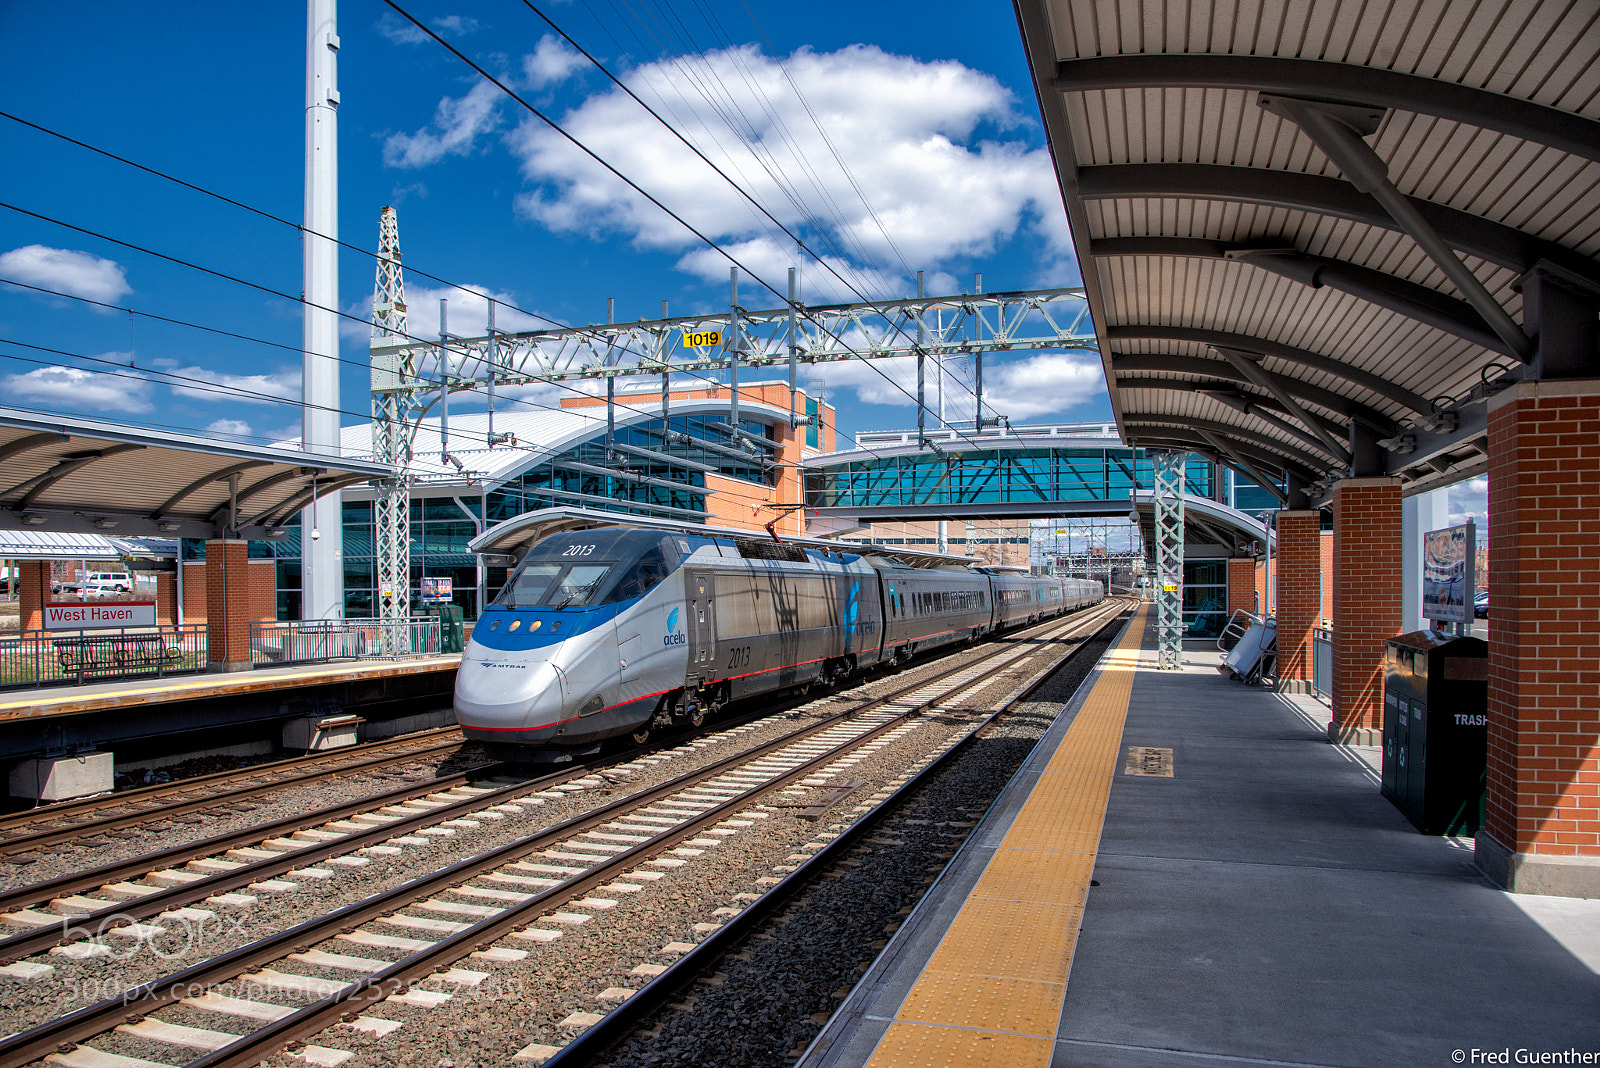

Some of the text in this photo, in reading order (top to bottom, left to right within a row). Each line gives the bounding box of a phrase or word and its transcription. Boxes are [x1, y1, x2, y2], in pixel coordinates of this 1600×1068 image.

[687, 332, 719, 346] 1019
[562, 544, 596, 556] 2013
[49, 607, 133, 621] West Haven
[663, 630, 686, 646] acela
[727, 646, 751, 669] 2013
